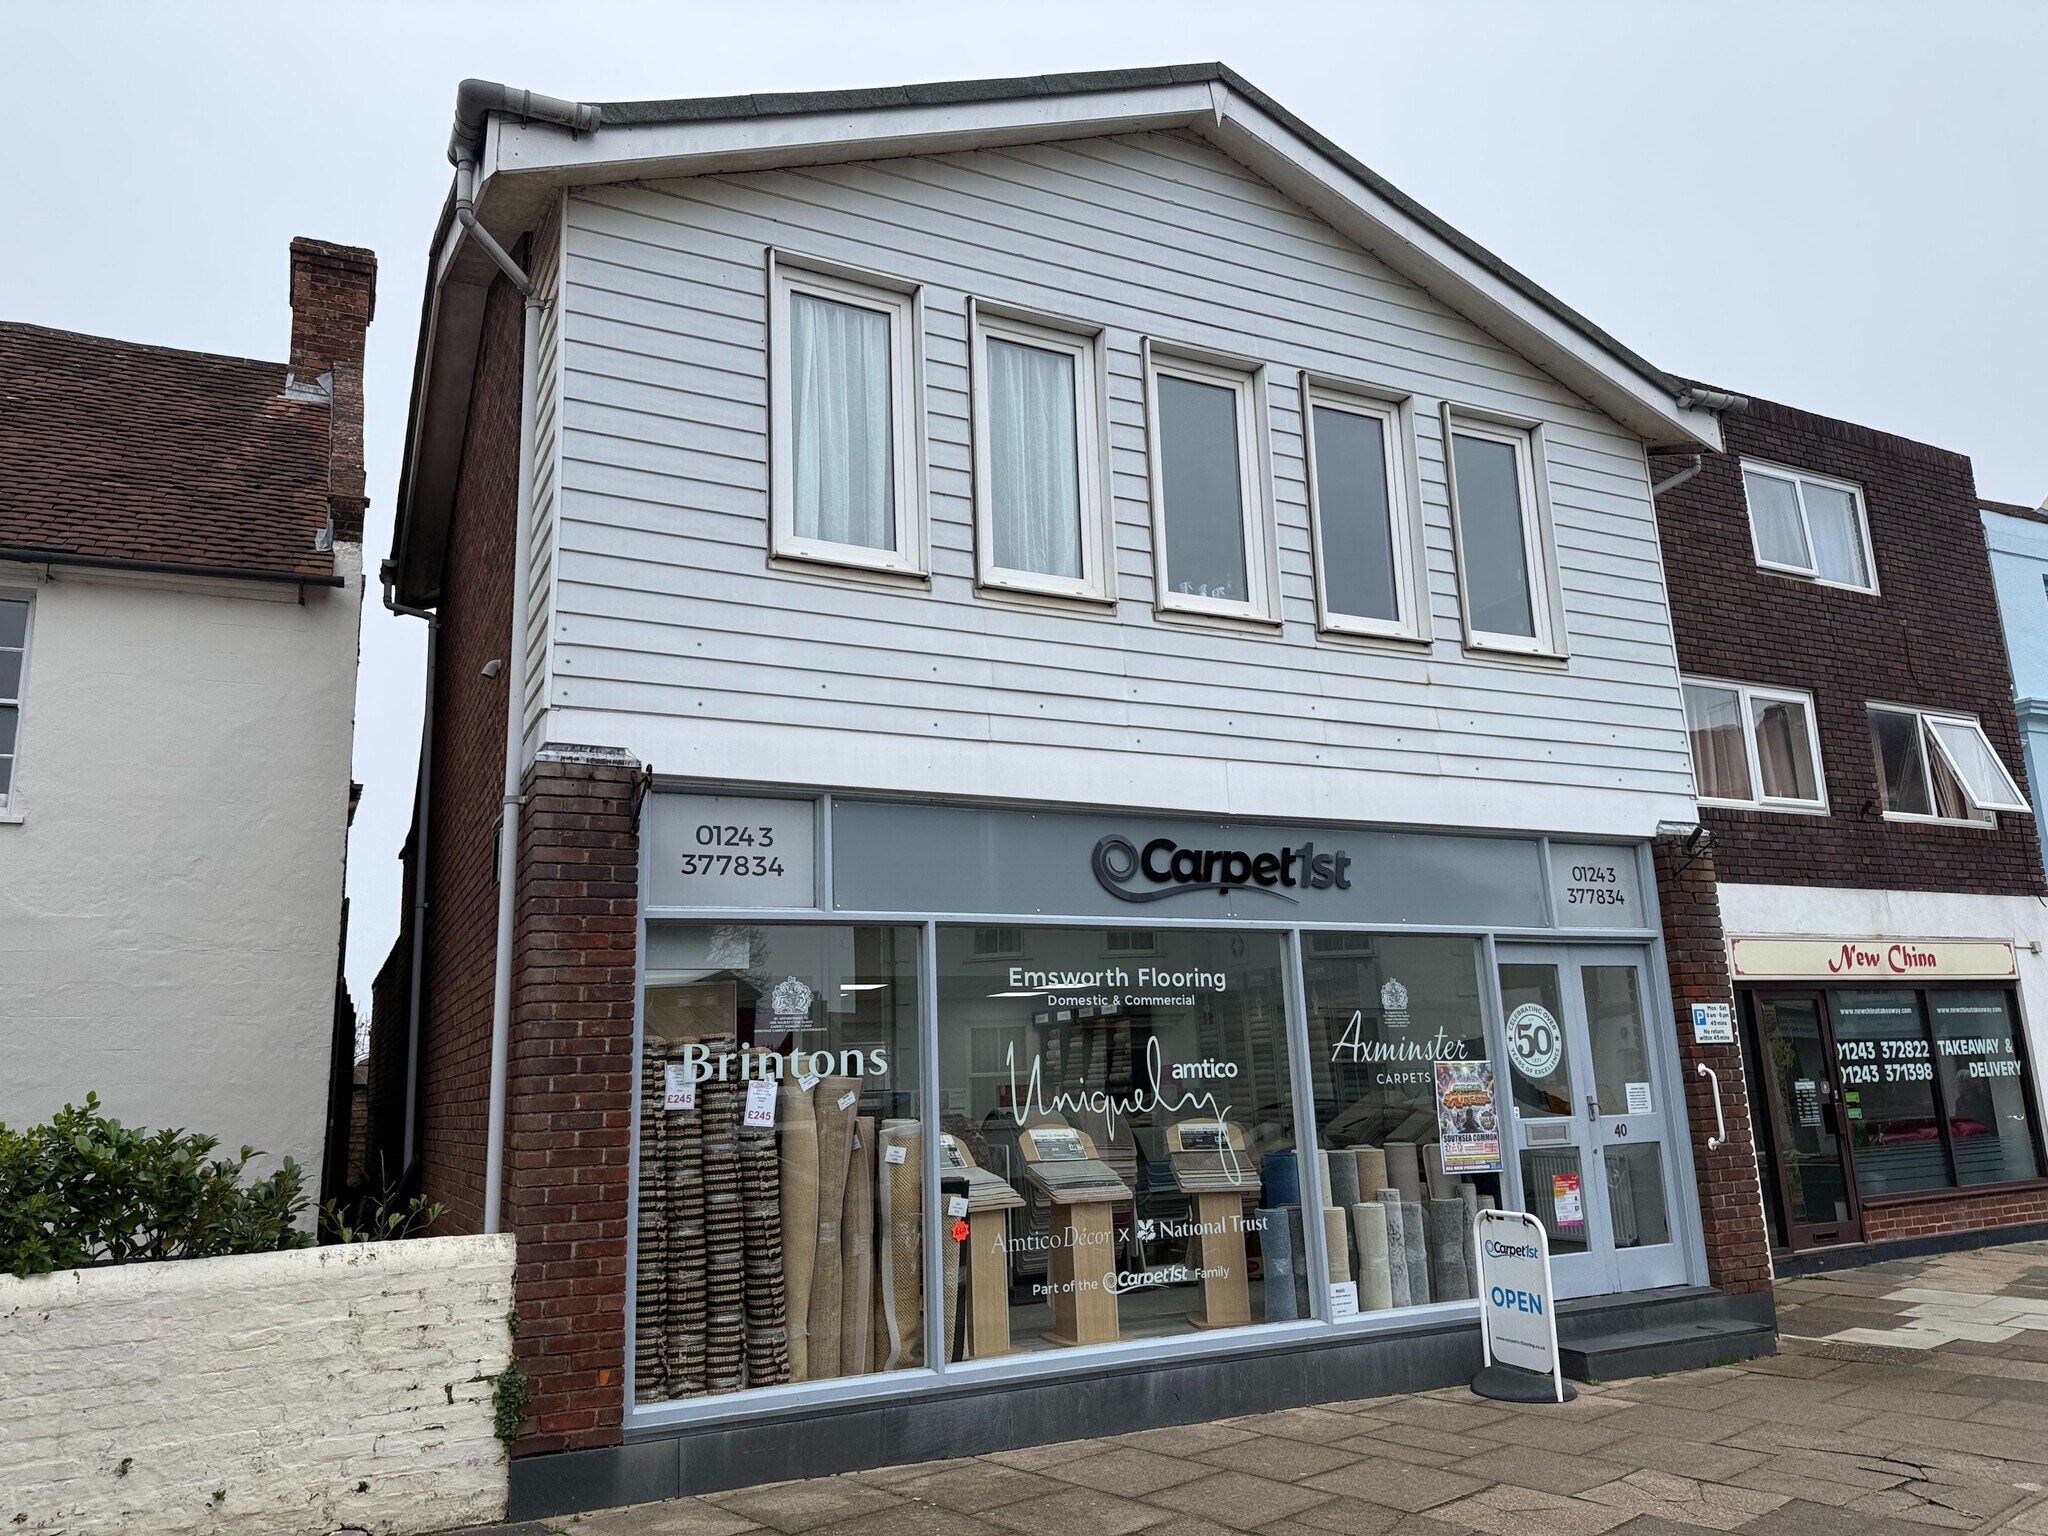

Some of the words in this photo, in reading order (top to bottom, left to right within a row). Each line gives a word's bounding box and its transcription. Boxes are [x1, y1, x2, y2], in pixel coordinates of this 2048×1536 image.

[695, 824, 774, 848] 01243
[681, 854, 785, 877] 377834
[1141, 838, 1351, 895] Carpet1st
[1572, 866, 1616, 883] 01243
[1567, 888, 1625, 905] 377834
[1828, 944, 1880, 973] New
[1888, 944, 1936, 973] China
[1009, 967, 1129, 987] Emsworth
[1138, 967, 1226, 992] Flooring
[1048, 994, 1108, 1006] Domestic
[1112, 995, 1121, 1006] &
[1124, 994, 1195, 1006] Commercial
[1508, 1005, 1542, 1031] CELEBRATING
[1543, 1012, 1557, 1030] OVER
[1696, 1010, 1704, 1025] P
[1840, 1007, 1912, 1015] www.newchinatakeaway.com
[1332, 1010, 1468, 1062] Axminster
[1517, 1023, 1552, 1058] 50
[1880, 1040, 1930, 1059] 372822
[1937, 1038, 1999, 1056] TAKEAWAY
[2004, 1038, 2014, 1053] &
[683, 1042, 888, 1083] Brintons
[1171, 1057, 1238, 1079] amtico
[1511, 1048, 1525, 1069] YEARS
[1525, 1066, 1533, 1074] OF
[1534, 1048, 1560, 1075] EXCELLENCE
[1968, 1060, 2022, 1078] DELIVERY
[1376, 1072, 1431, 1084] CARPETS
[1885, 1063, 1934, 1082] 371398
[667, 1094, 692, 1104] £245
[747, 1110, 771, 1120] £245
[1006, 1035, 1241, 1186] Uniquely
[1443, 1134, 1472, 1143] SOUTHSEA
[1472, 1133, 1498, 1142] COMMON
[1614, 1123, 1627, 1138] 40
[991, 1230, 1061, 1254] Amtico
[1063, 1225, 1111, 1248] Décor
[1159, 1218, 1226, 1239] National
[1229, 1214, 1268, 1232] Trust
[1494, 1241, 1538, 1259] Carpet1st
[1032, 1283, 1059, 1295] Part
[1063, 1281, 1075, 1293] of
[1076, 1279, 1098, 1292] the
[1117, 1265, 1188, 1289] Carpet1st
[1195, 1266, 1230, 1280] Family
[1491, 1286, 1543, 1315] OPEN
